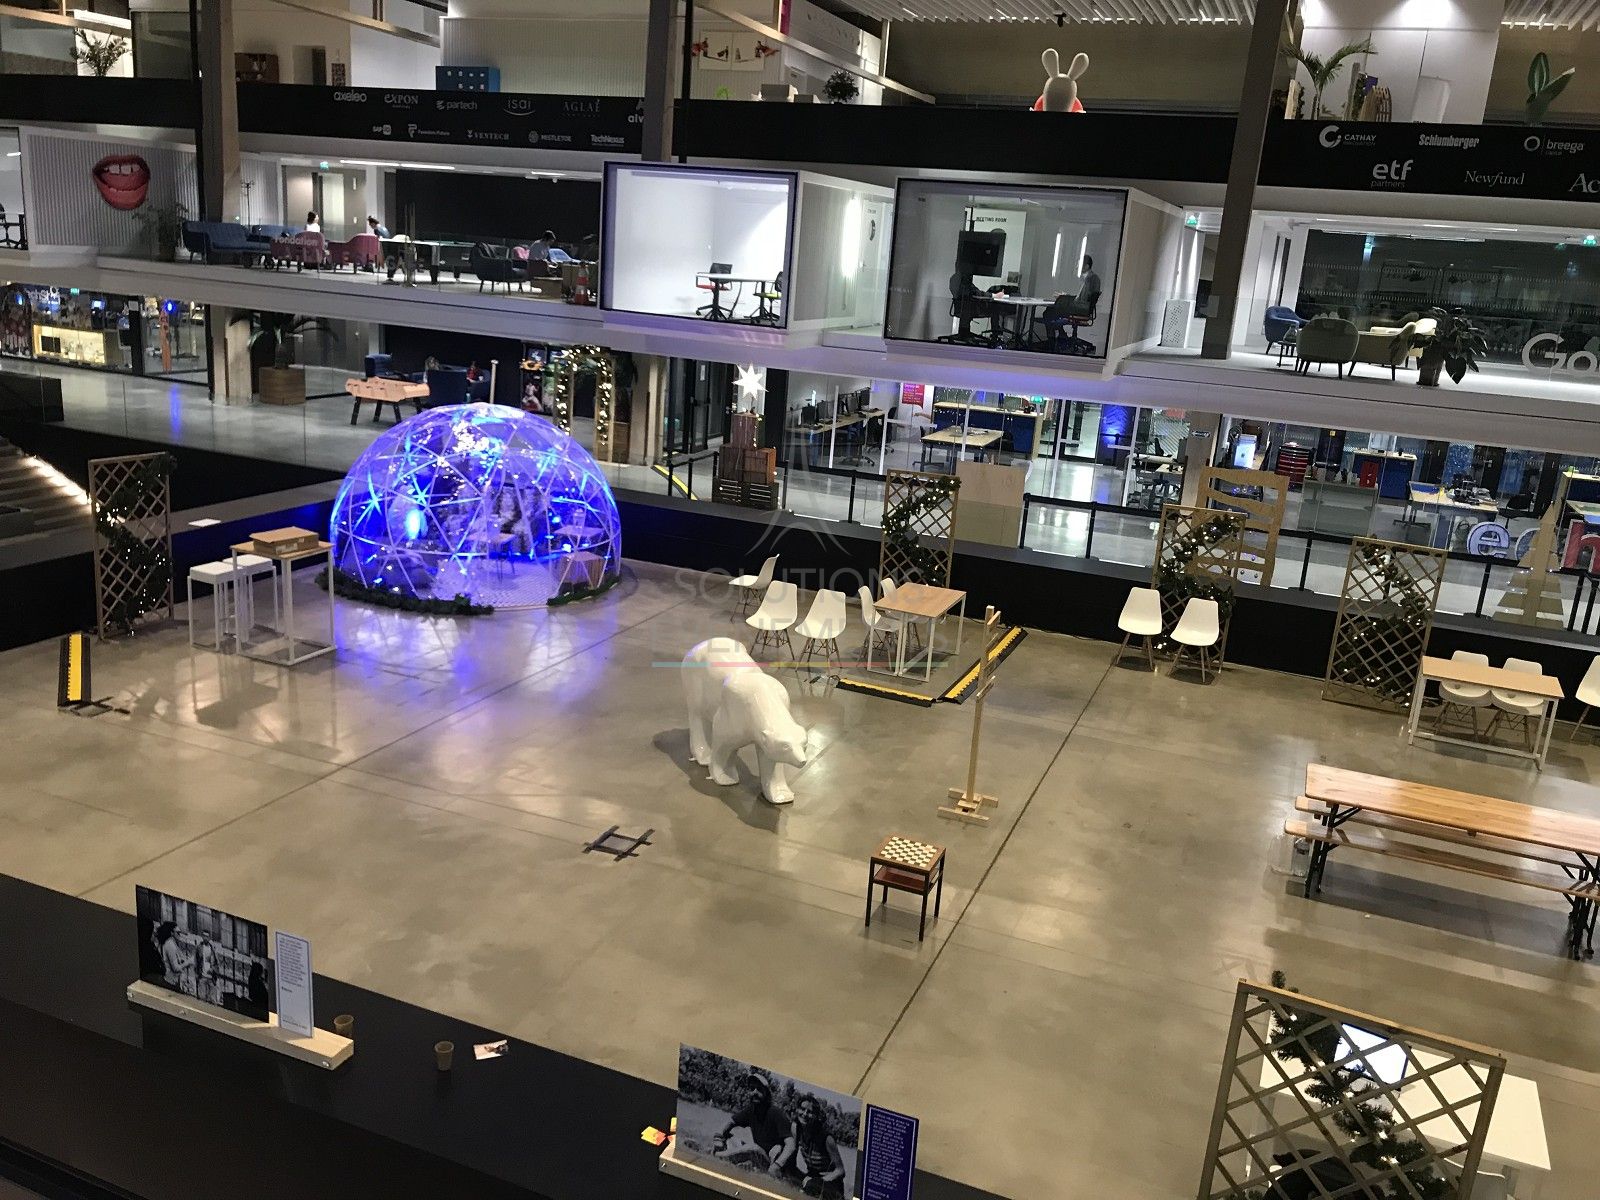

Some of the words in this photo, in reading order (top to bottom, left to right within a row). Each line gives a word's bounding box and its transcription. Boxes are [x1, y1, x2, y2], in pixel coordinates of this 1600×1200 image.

[446, 100, 477, 111] partech
[1344, 134, 1377, 142] CATHAY
[1419, 134, 1479, 149] Schlumberger
[1546, 138, 1584, 154] breega
[1372, 159, 1414, 181] etf
[1370, 178, 1405, 189] partners
[1464, 169, 1526, 188] Newfund
